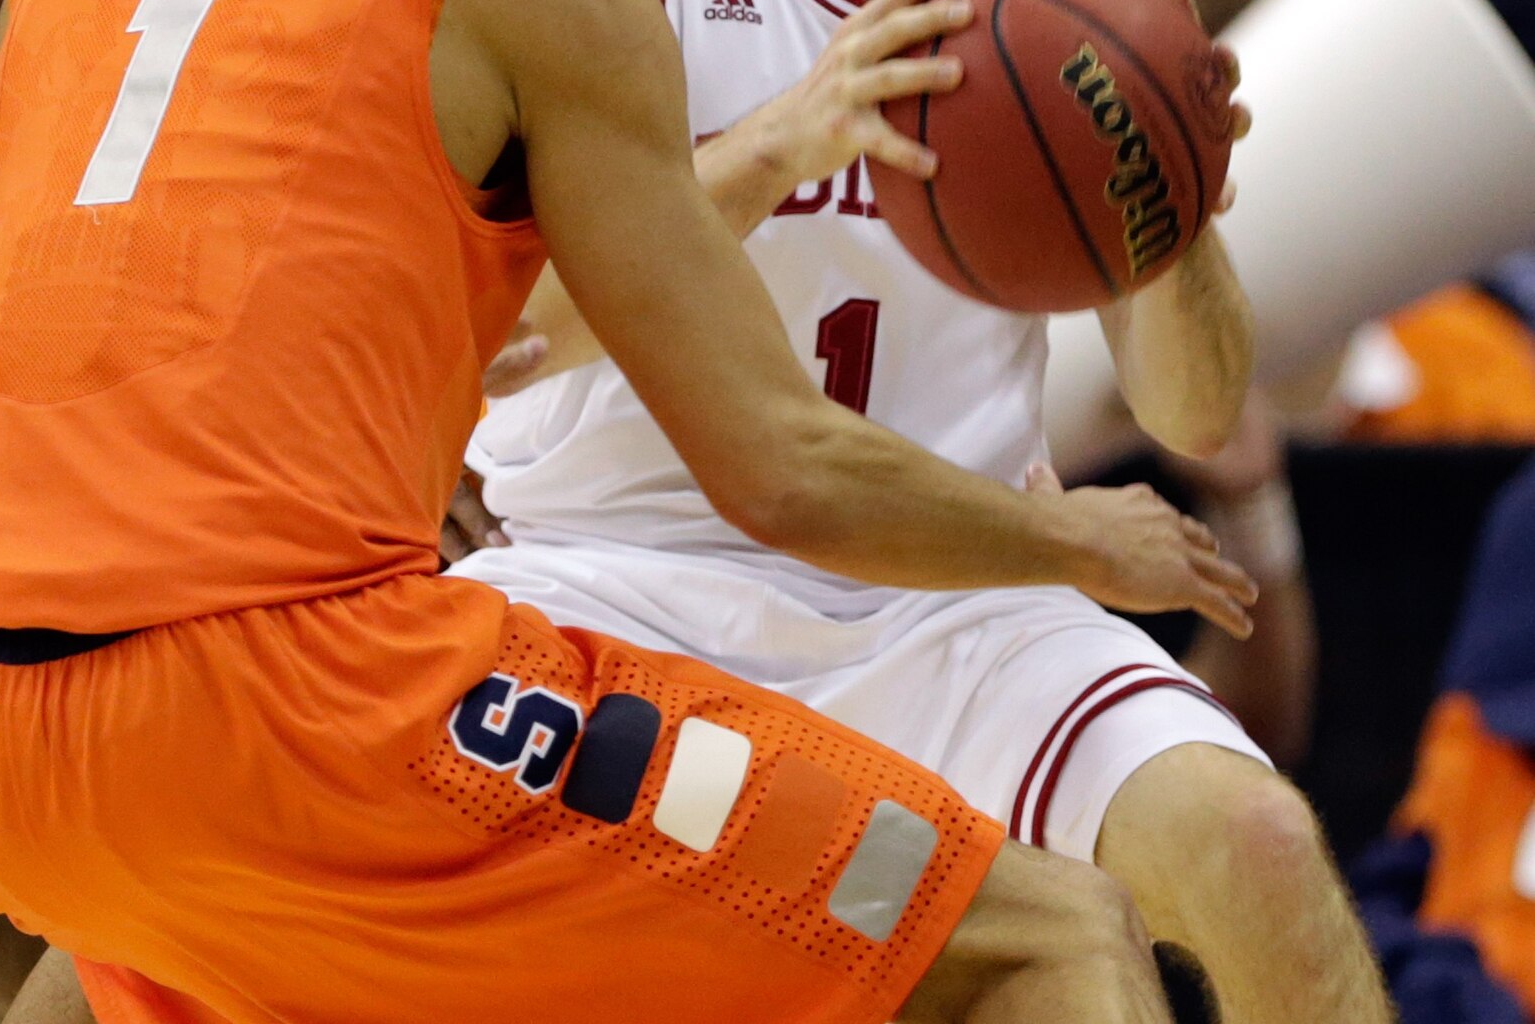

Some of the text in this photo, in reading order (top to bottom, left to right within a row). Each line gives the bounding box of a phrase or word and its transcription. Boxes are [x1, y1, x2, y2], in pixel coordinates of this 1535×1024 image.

[704, 4, 763, 26] adidas
[815, 298, 880, 416] 1
[447, 671, 584, 795] S
